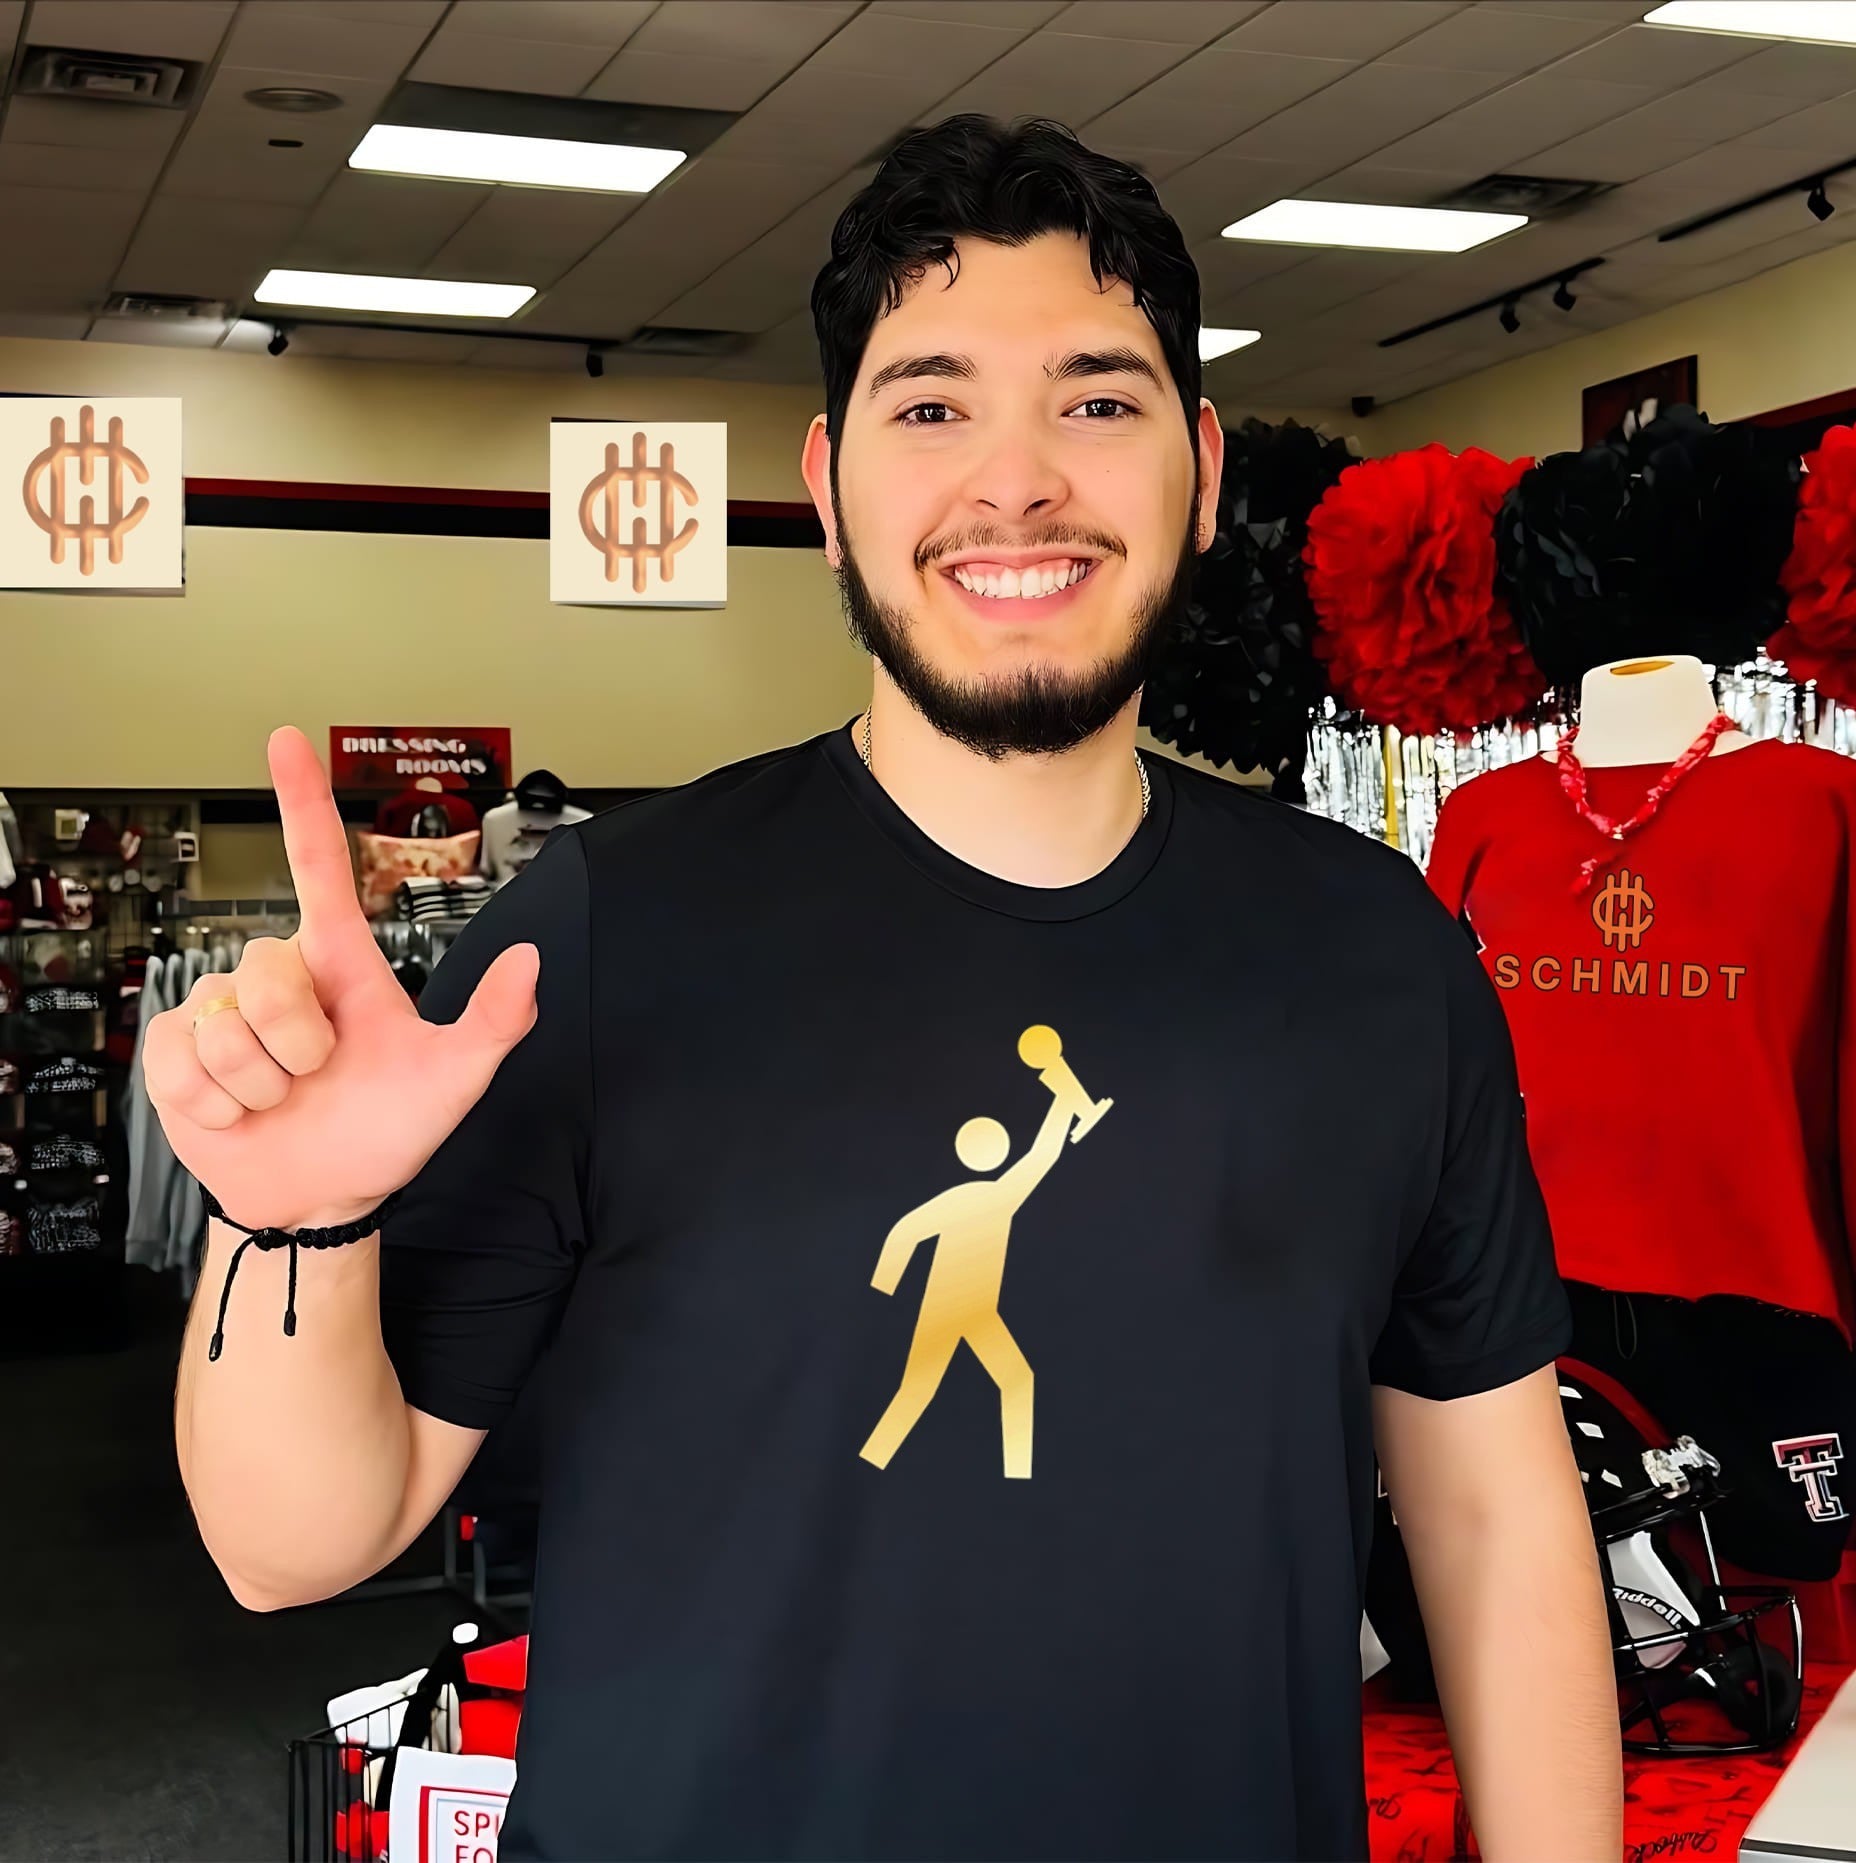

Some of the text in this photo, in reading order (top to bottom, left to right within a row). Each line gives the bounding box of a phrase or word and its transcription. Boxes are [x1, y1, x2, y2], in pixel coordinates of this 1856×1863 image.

[342, 737, 467, 753] DRESSING
[396, 758, 487, 775] ROOMS
[1493, 953, 1747, 1001] SCHMIDT
